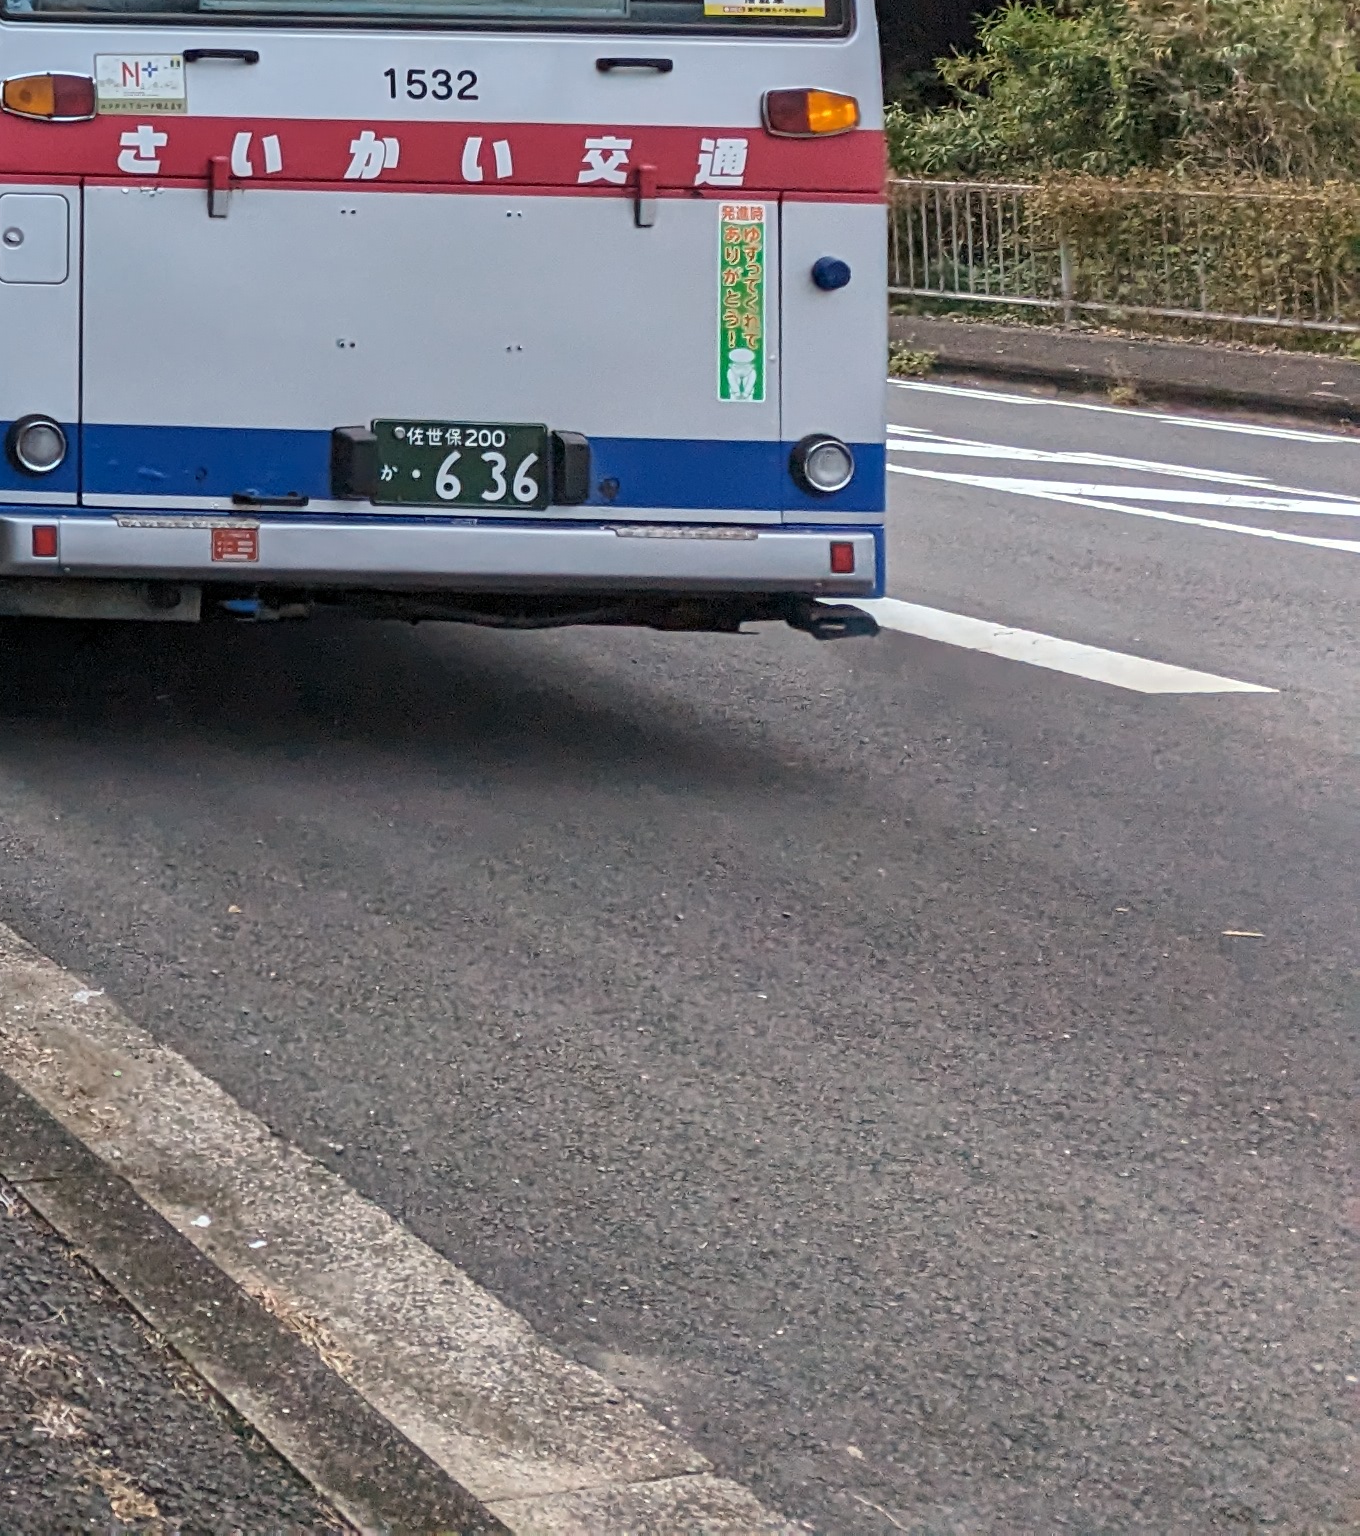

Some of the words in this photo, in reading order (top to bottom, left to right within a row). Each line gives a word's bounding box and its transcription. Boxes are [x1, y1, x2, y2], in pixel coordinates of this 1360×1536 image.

[383, 67, 480, 101] 1532
[117, 124, 750, 188] さいかい交通
[721, 205, 764, 222] 発進時
[380, 464, 399, 482] か
